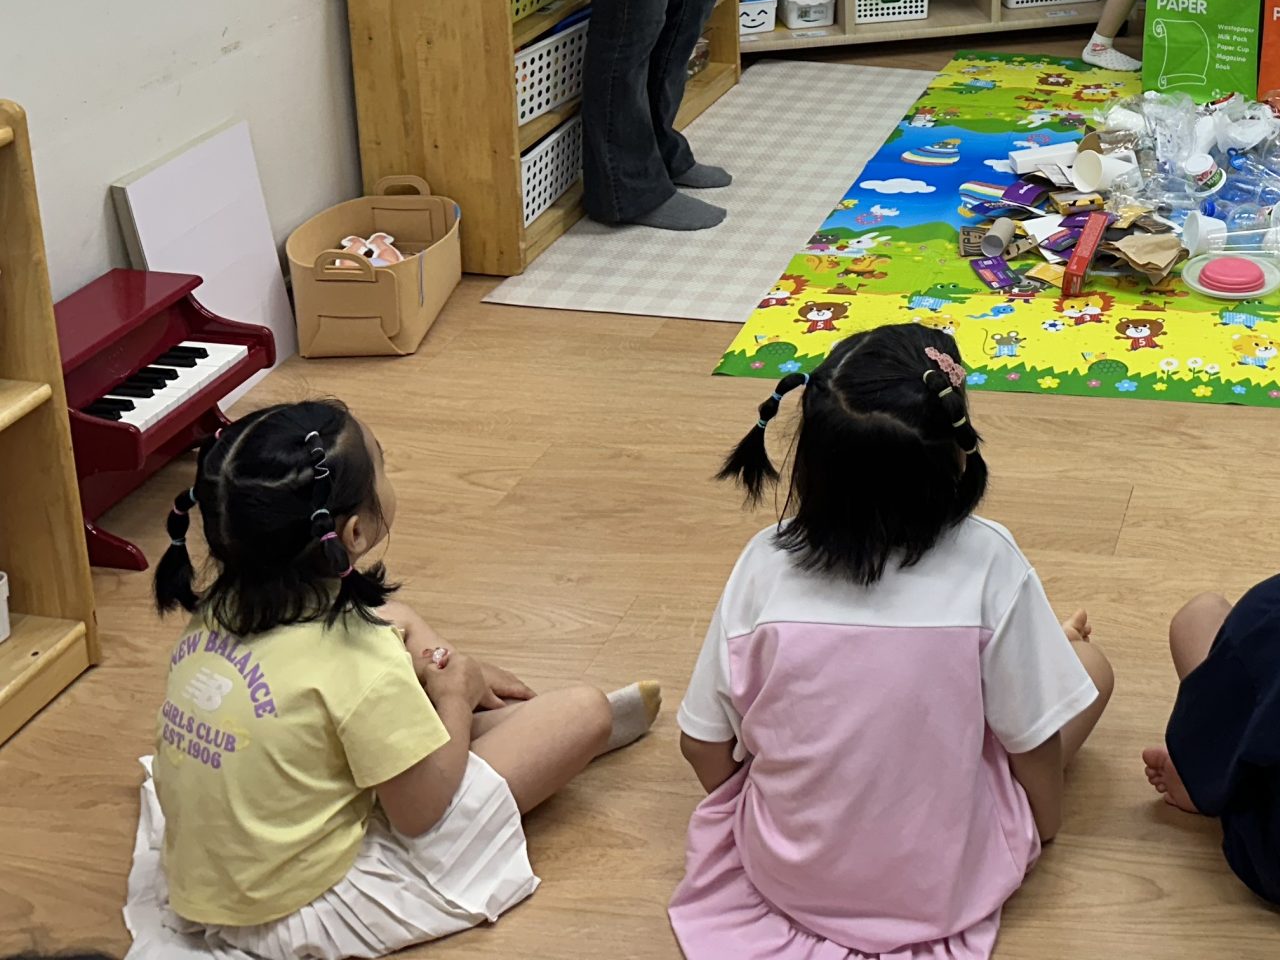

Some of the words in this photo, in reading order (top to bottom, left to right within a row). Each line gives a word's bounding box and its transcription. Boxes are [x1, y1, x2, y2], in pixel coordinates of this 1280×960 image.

[1217, 24, 1254, 33] Wastepaper
[1216, 43, 1235, 51] Paper
[1236, 45, 1250, 53] Cup
[1216, 53, 1247, 62] Magazine
[816, 321, 824, 329] 5
[1138, 338, 1146, 346] 5
[169, 630, 204, 672] NEW
[204, 630, 277, 718] BALANCE
[162, 700, 195, 734] GIRLS
[196, 722, 237, 752] CLUB
